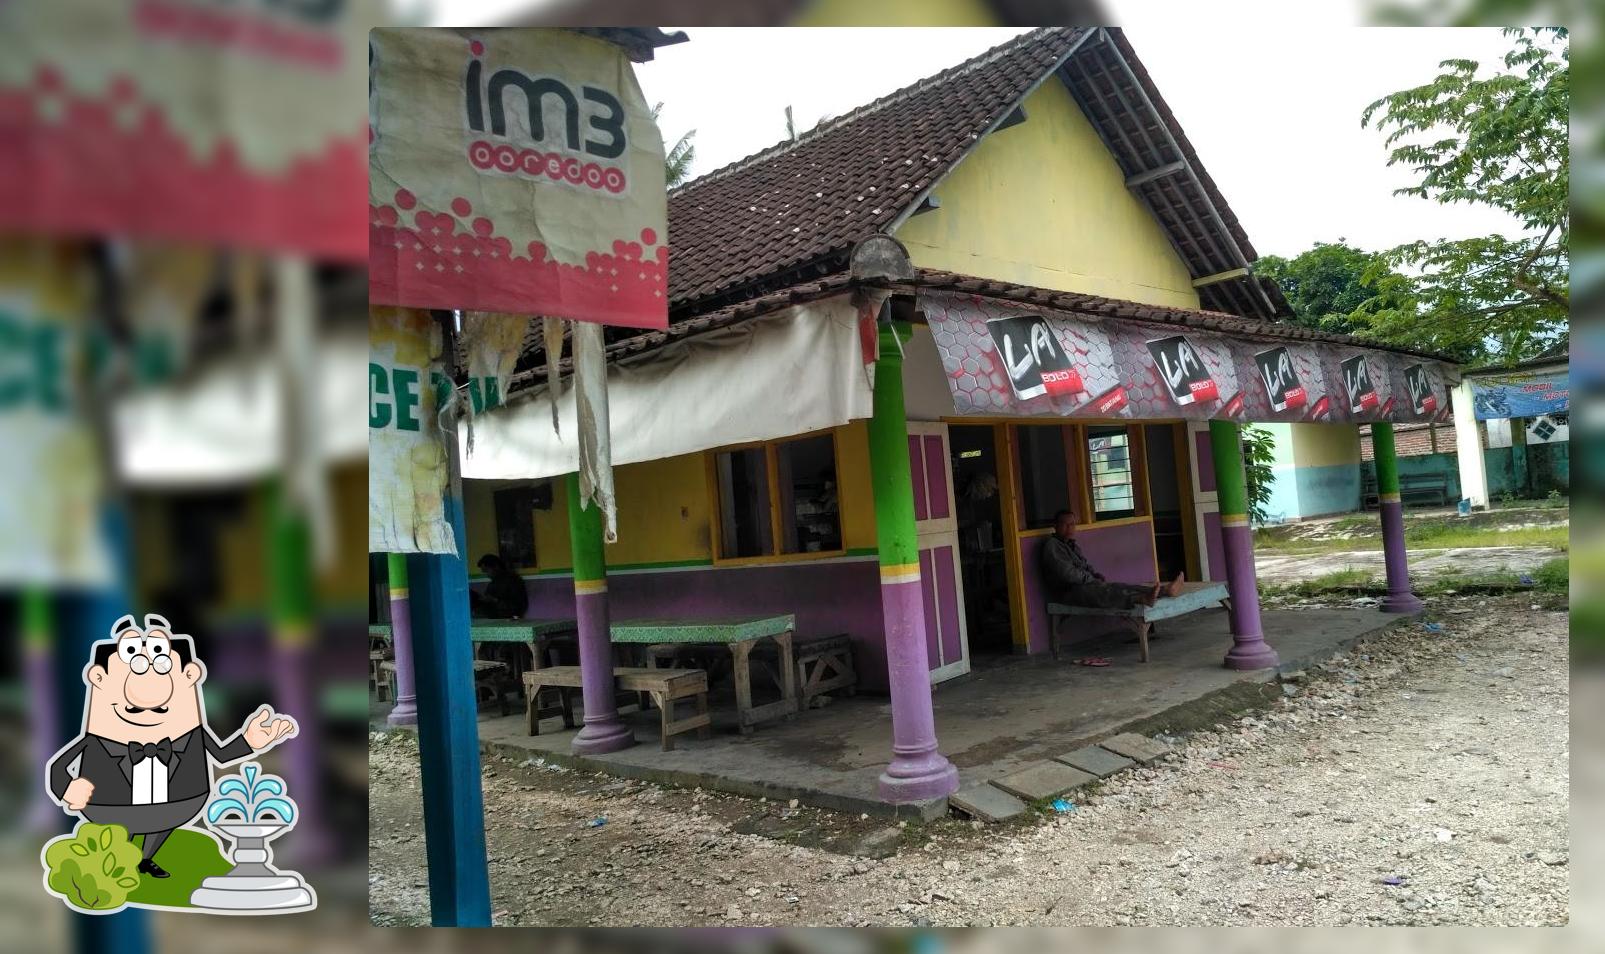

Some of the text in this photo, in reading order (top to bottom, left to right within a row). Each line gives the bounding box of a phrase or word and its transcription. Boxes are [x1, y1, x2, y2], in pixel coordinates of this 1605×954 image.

[471, 143, 625, 192] ooredoo
[1003, 322, 1056, 380] LA
[1161, 341, 1199, 389] LA
[1041, 370, 1070, 383] BOLD
[1264, 352, 1293, 397] LA
[1347, 359, 1368, 401] LA
[1409, 368, 1428, 403] LA
